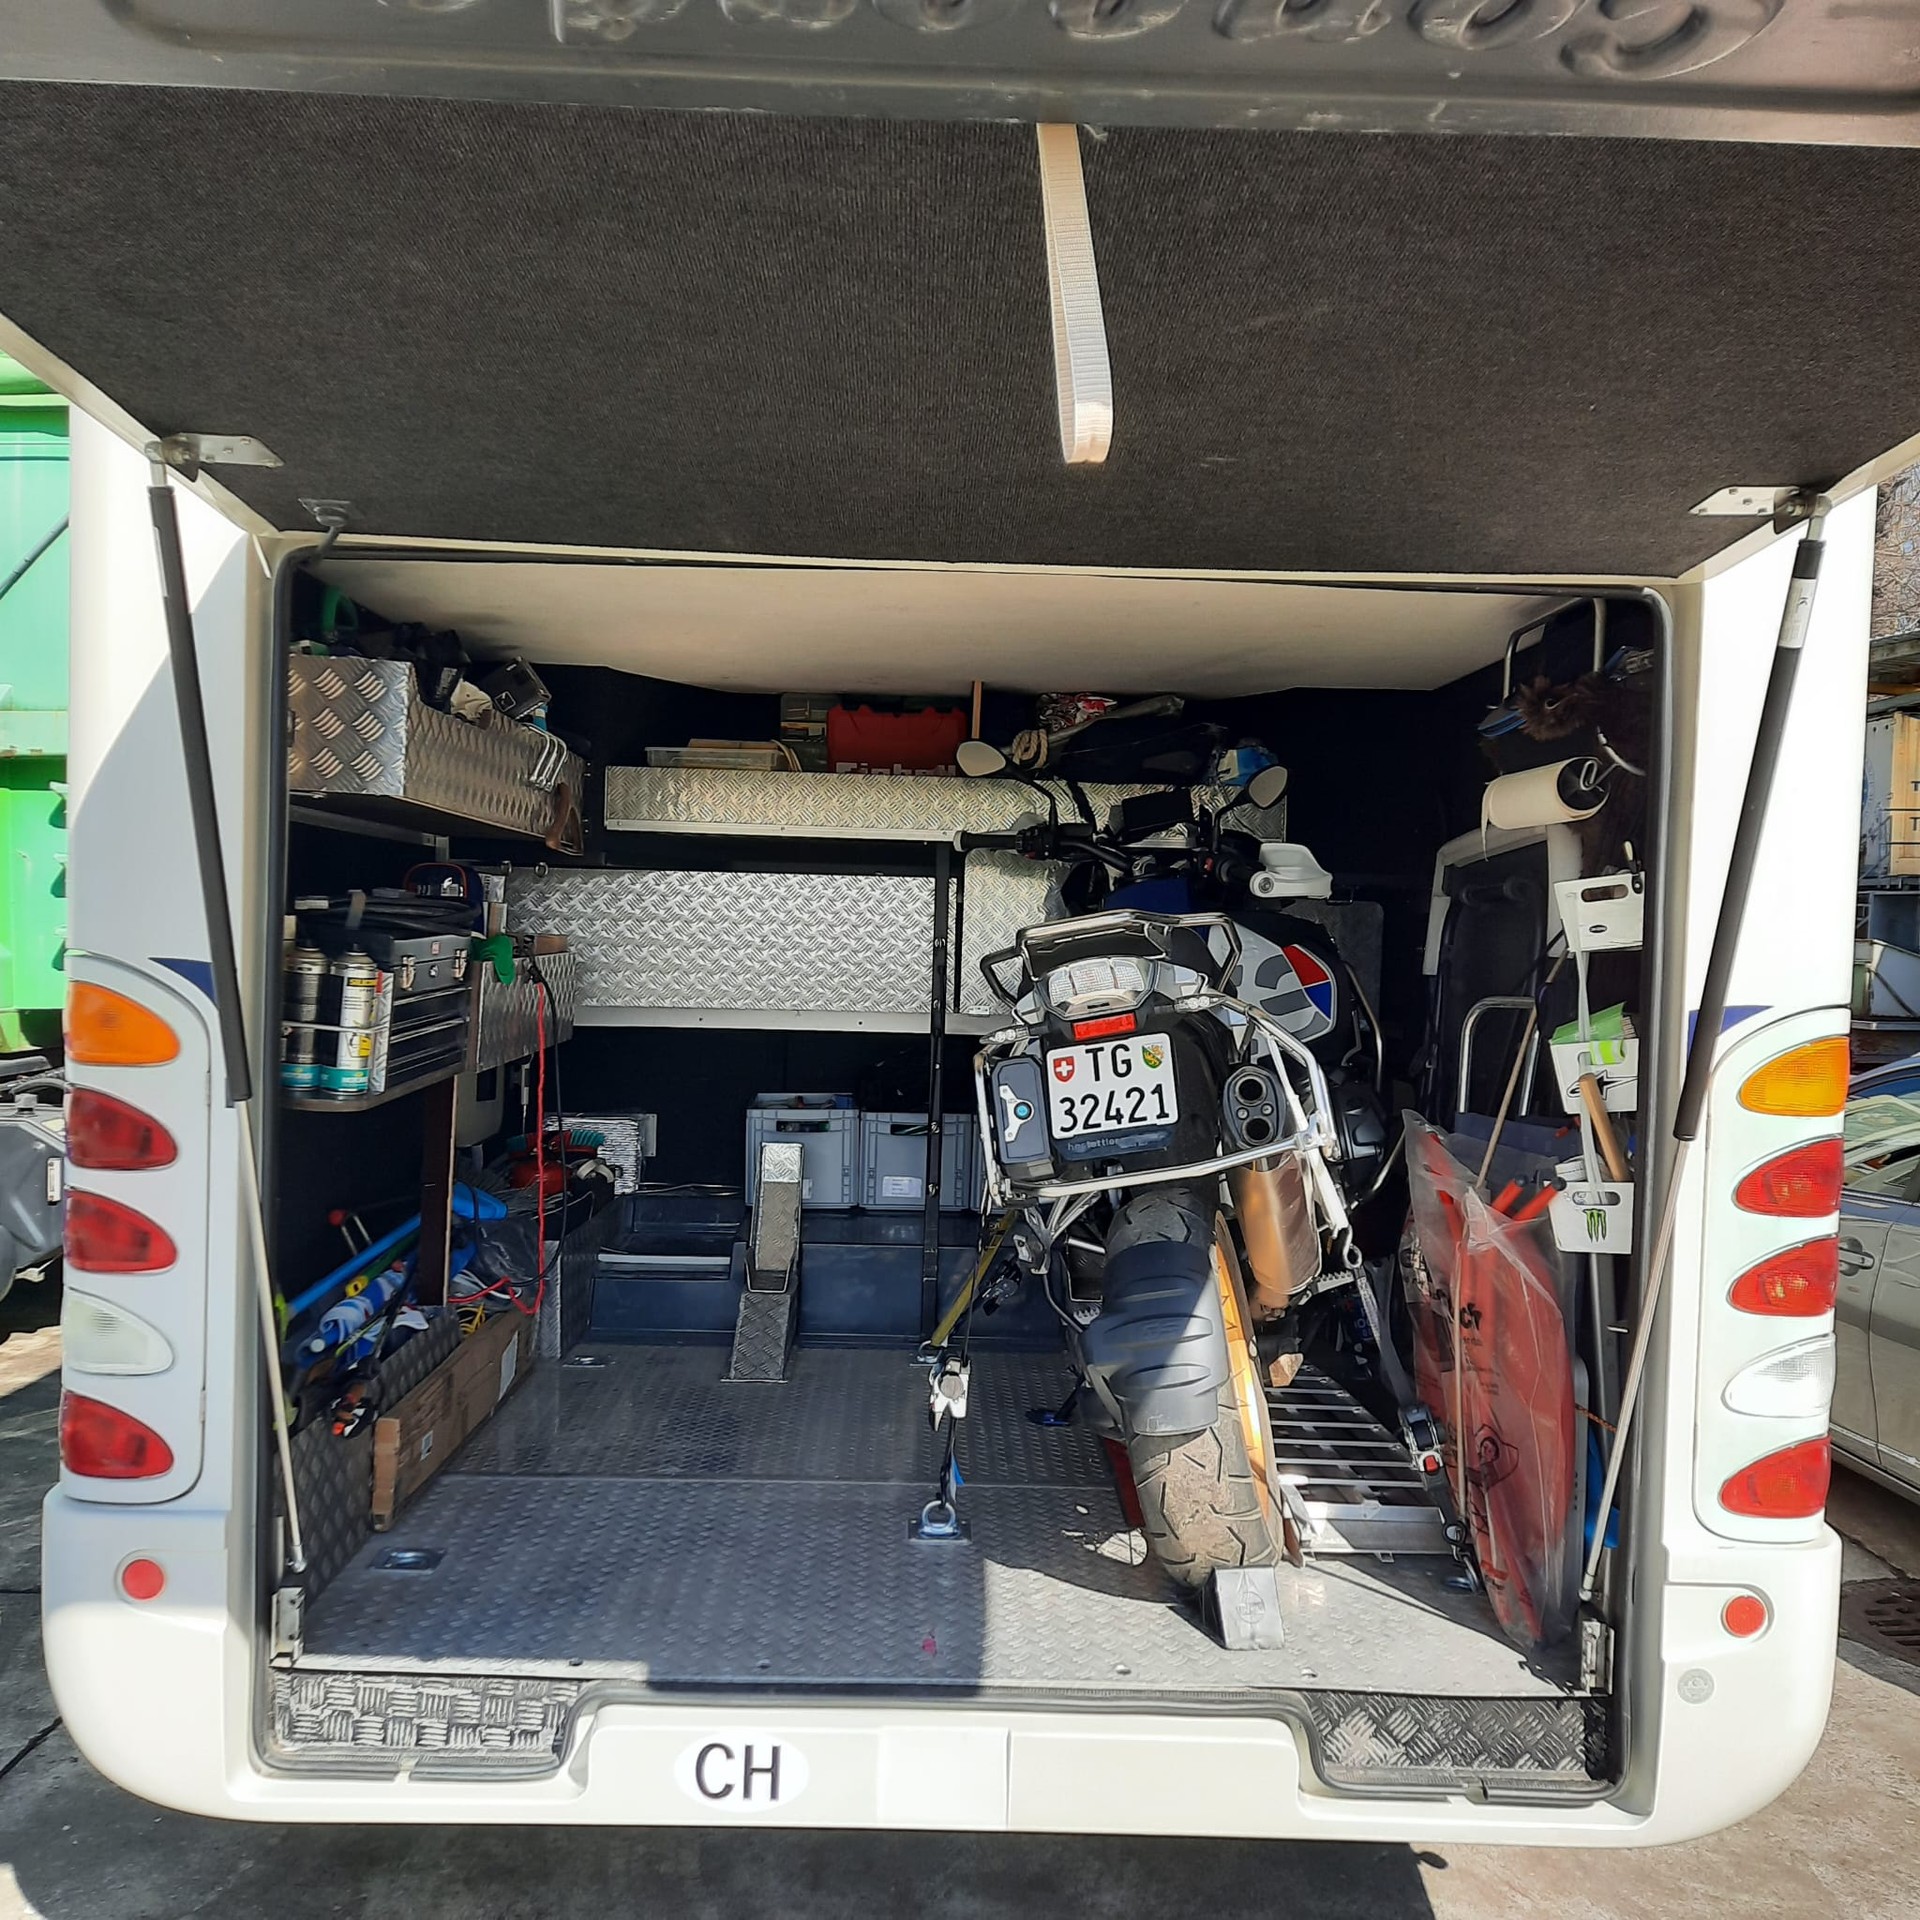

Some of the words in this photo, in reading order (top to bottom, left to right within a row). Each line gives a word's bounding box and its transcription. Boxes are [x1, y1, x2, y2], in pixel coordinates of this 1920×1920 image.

[1085, 1043, 1132, 1082] TG
[1059, 1083, 1170, 1133] 32421
[694, 1742, 781, 1801] CH
